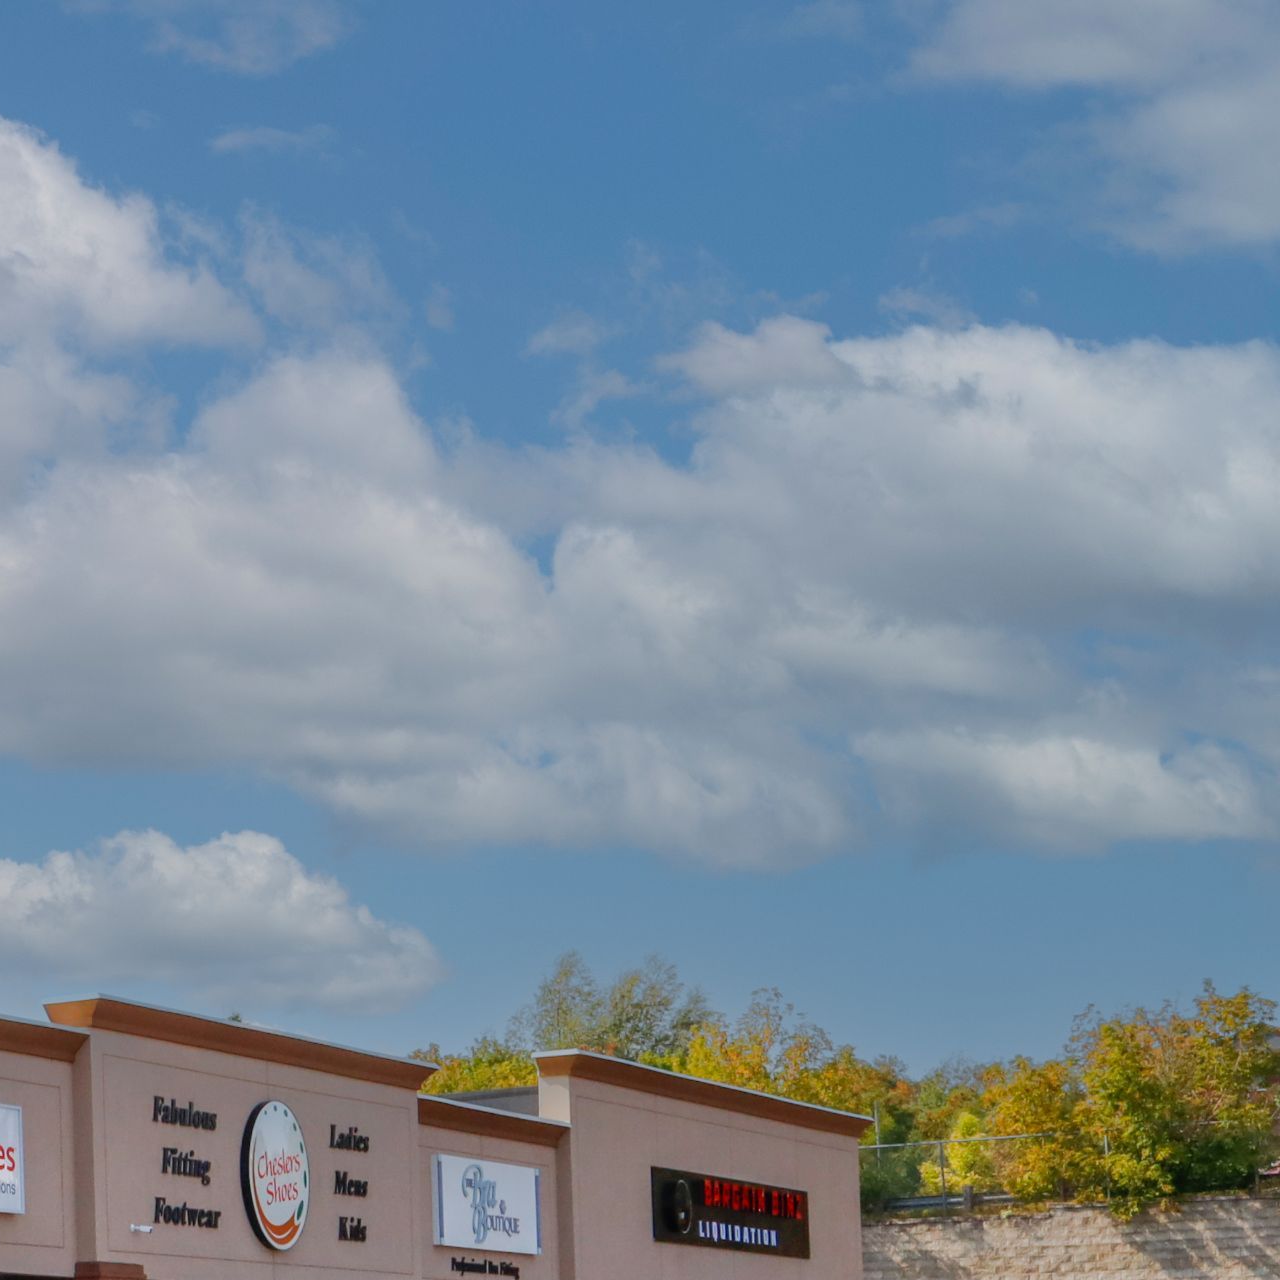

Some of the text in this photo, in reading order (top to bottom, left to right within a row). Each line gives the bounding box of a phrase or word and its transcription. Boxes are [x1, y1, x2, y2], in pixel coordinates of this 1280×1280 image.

[152, 1096, 217, 1131] Fabulous
[329, 1124, 370, 1153] Ladies
[161, 1147, 211, 1186] Fitting
[266, 1179, 300, 1206] Shoes
[333, 1170, 368, 1198] Mens
[153, 1197, 221, 1229] Footwear
[338, 1216, 367, 1242] Kids
[698, 1220, 777, 1247] LIQUIDATION
